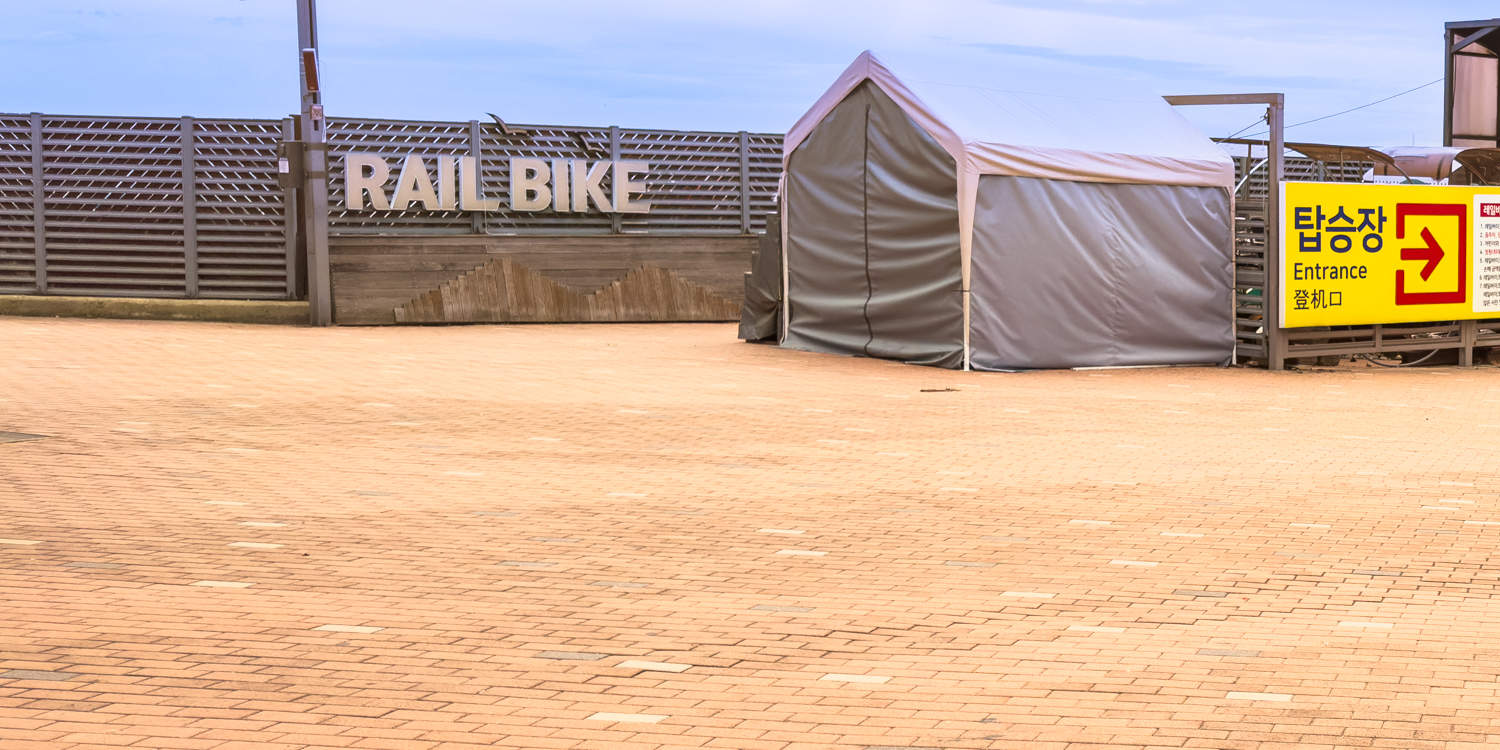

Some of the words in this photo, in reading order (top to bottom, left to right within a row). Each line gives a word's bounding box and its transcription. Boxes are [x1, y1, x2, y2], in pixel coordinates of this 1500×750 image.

[345, 152, 500, 212] RAIL
[510, 156, 650, 213] BIKE
[1294, 205, 1387, 253] 탑승장
[1294, 262, 1367, 281] Entrance
[1293, 288, 1342, 310] 登机口
